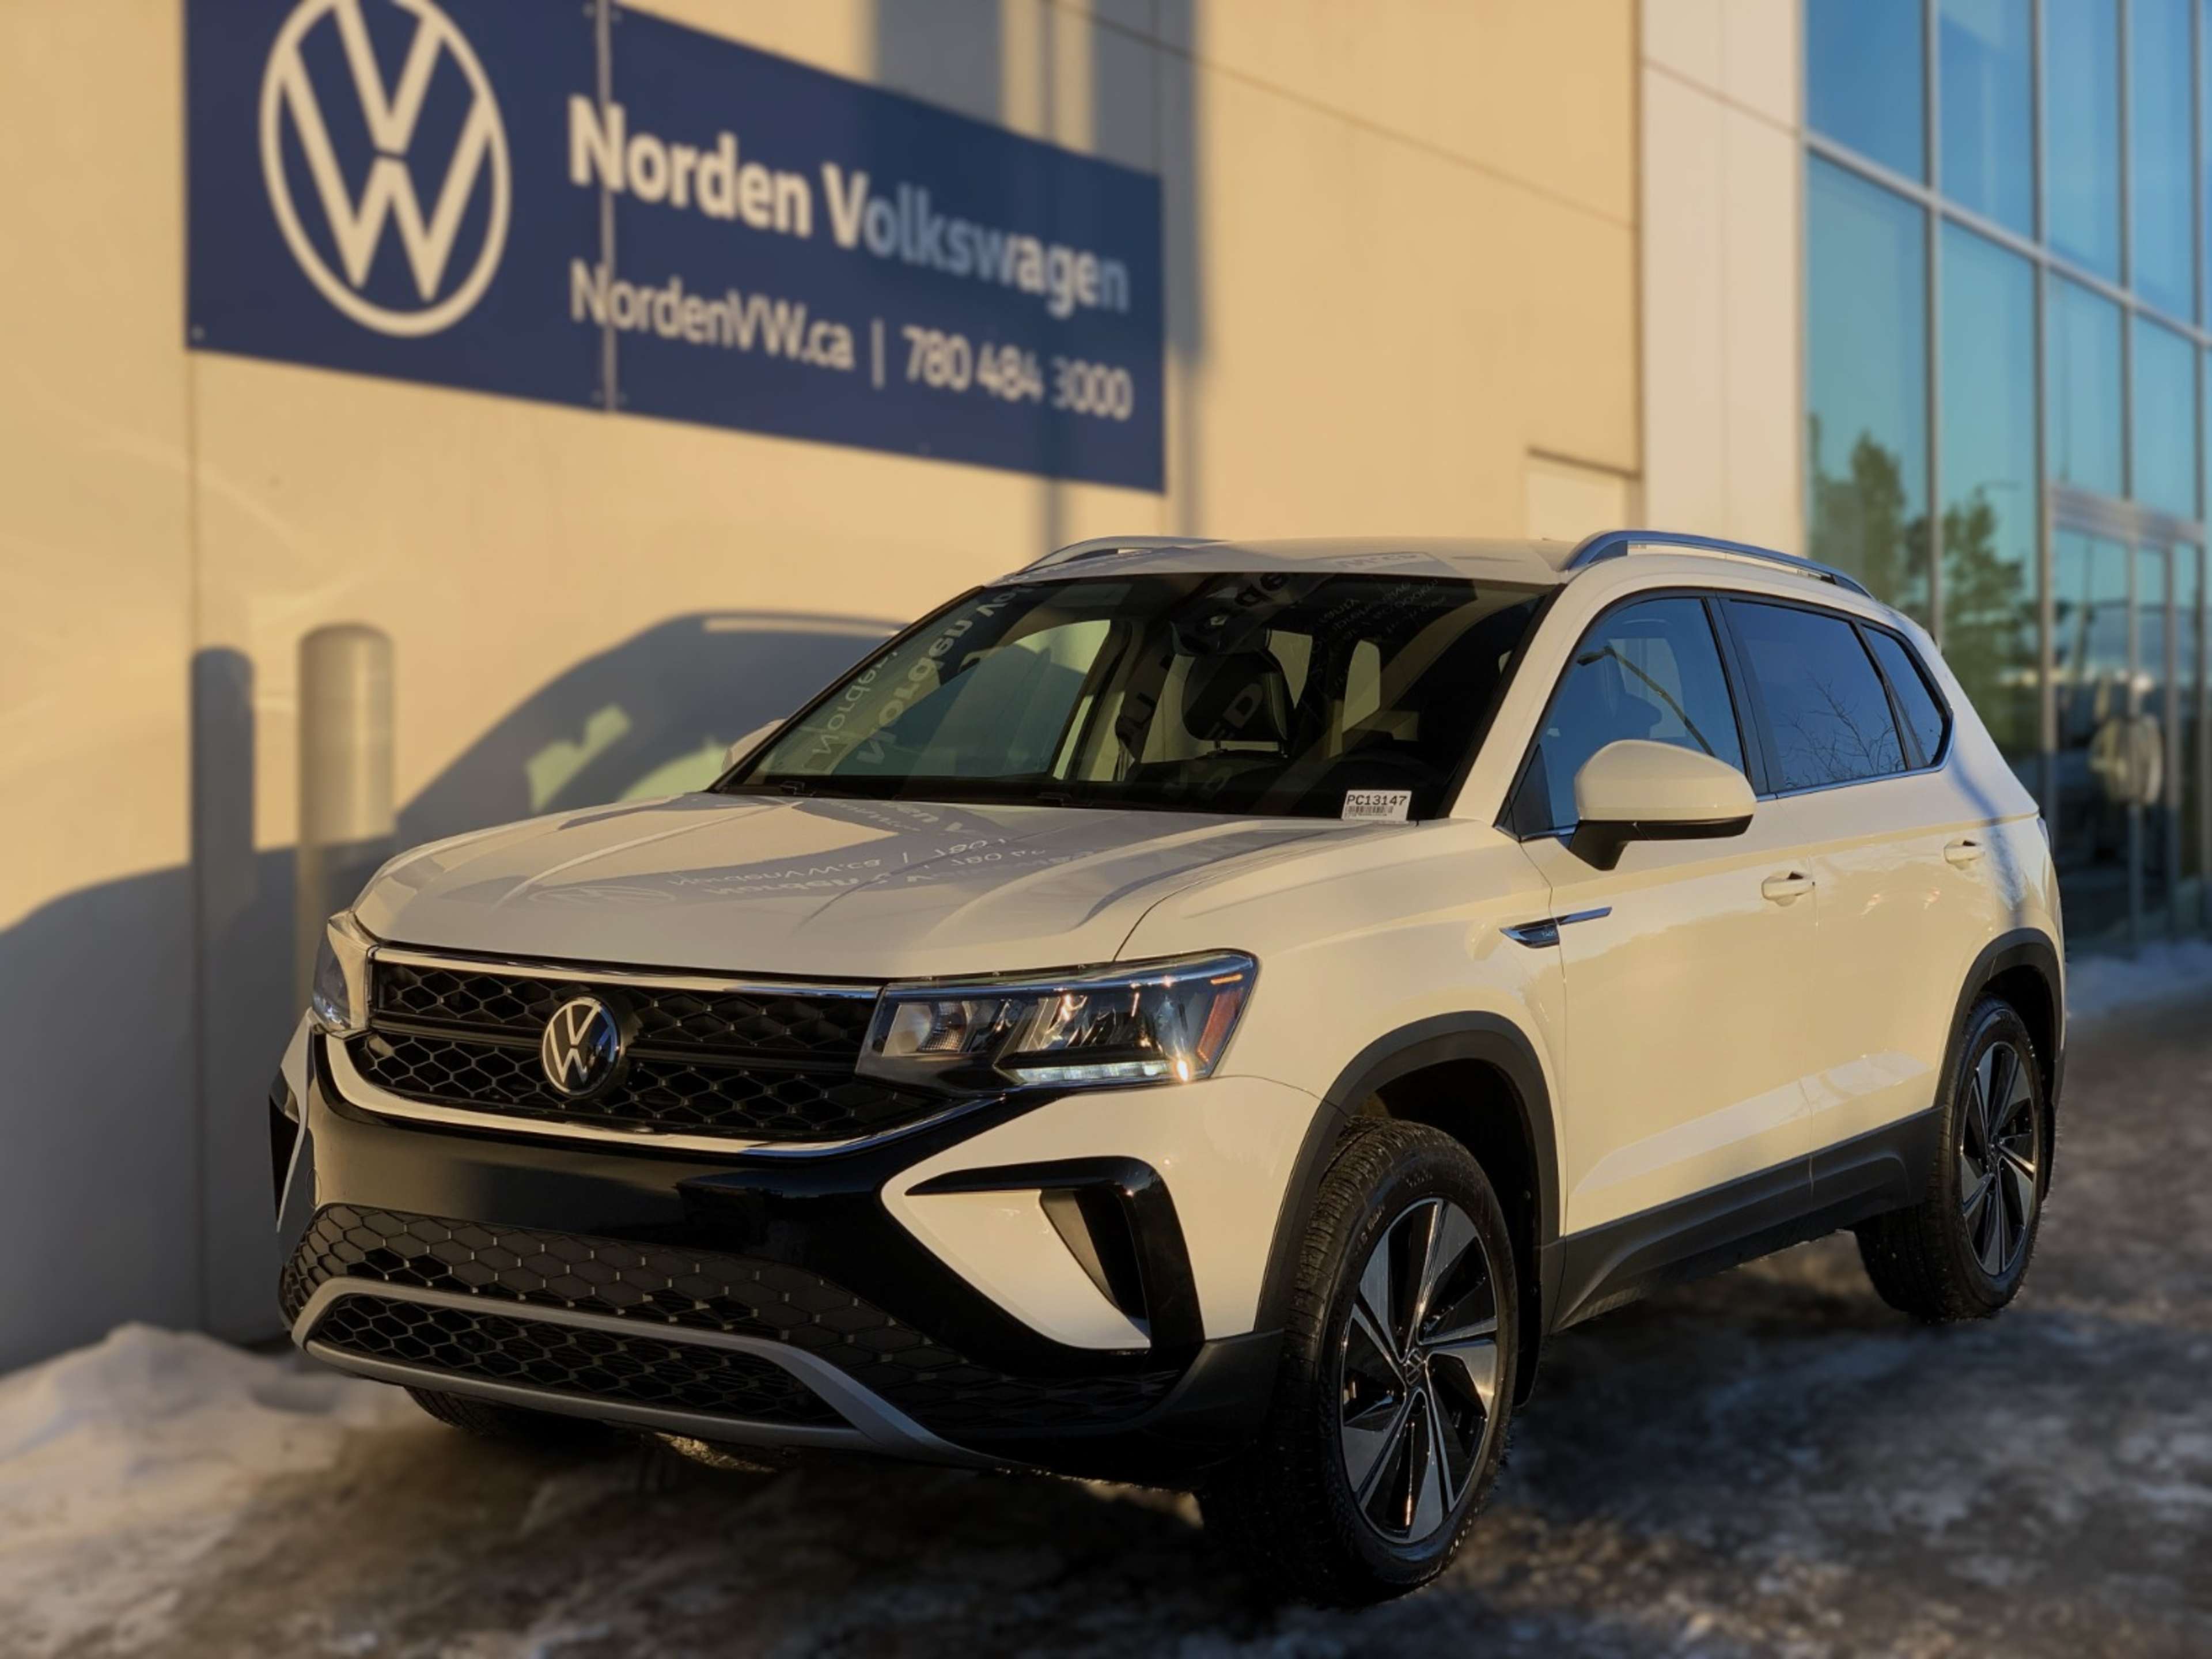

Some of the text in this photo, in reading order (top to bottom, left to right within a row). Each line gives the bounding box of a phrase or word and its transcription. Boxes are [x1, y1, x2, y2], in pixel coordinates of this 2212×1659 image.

[568, 93, 1130, 319] Norden Volkswagen
[569, 257, 855, 372] NordenVW.ca
[903, 325, 972, 392] 780
[977, 343, 1044, 403] 484
[1051, 355, 1134, 421] 3000
[1346, 794, 1407, 806] PC13147
[545, 999, 616, 1088] VW
